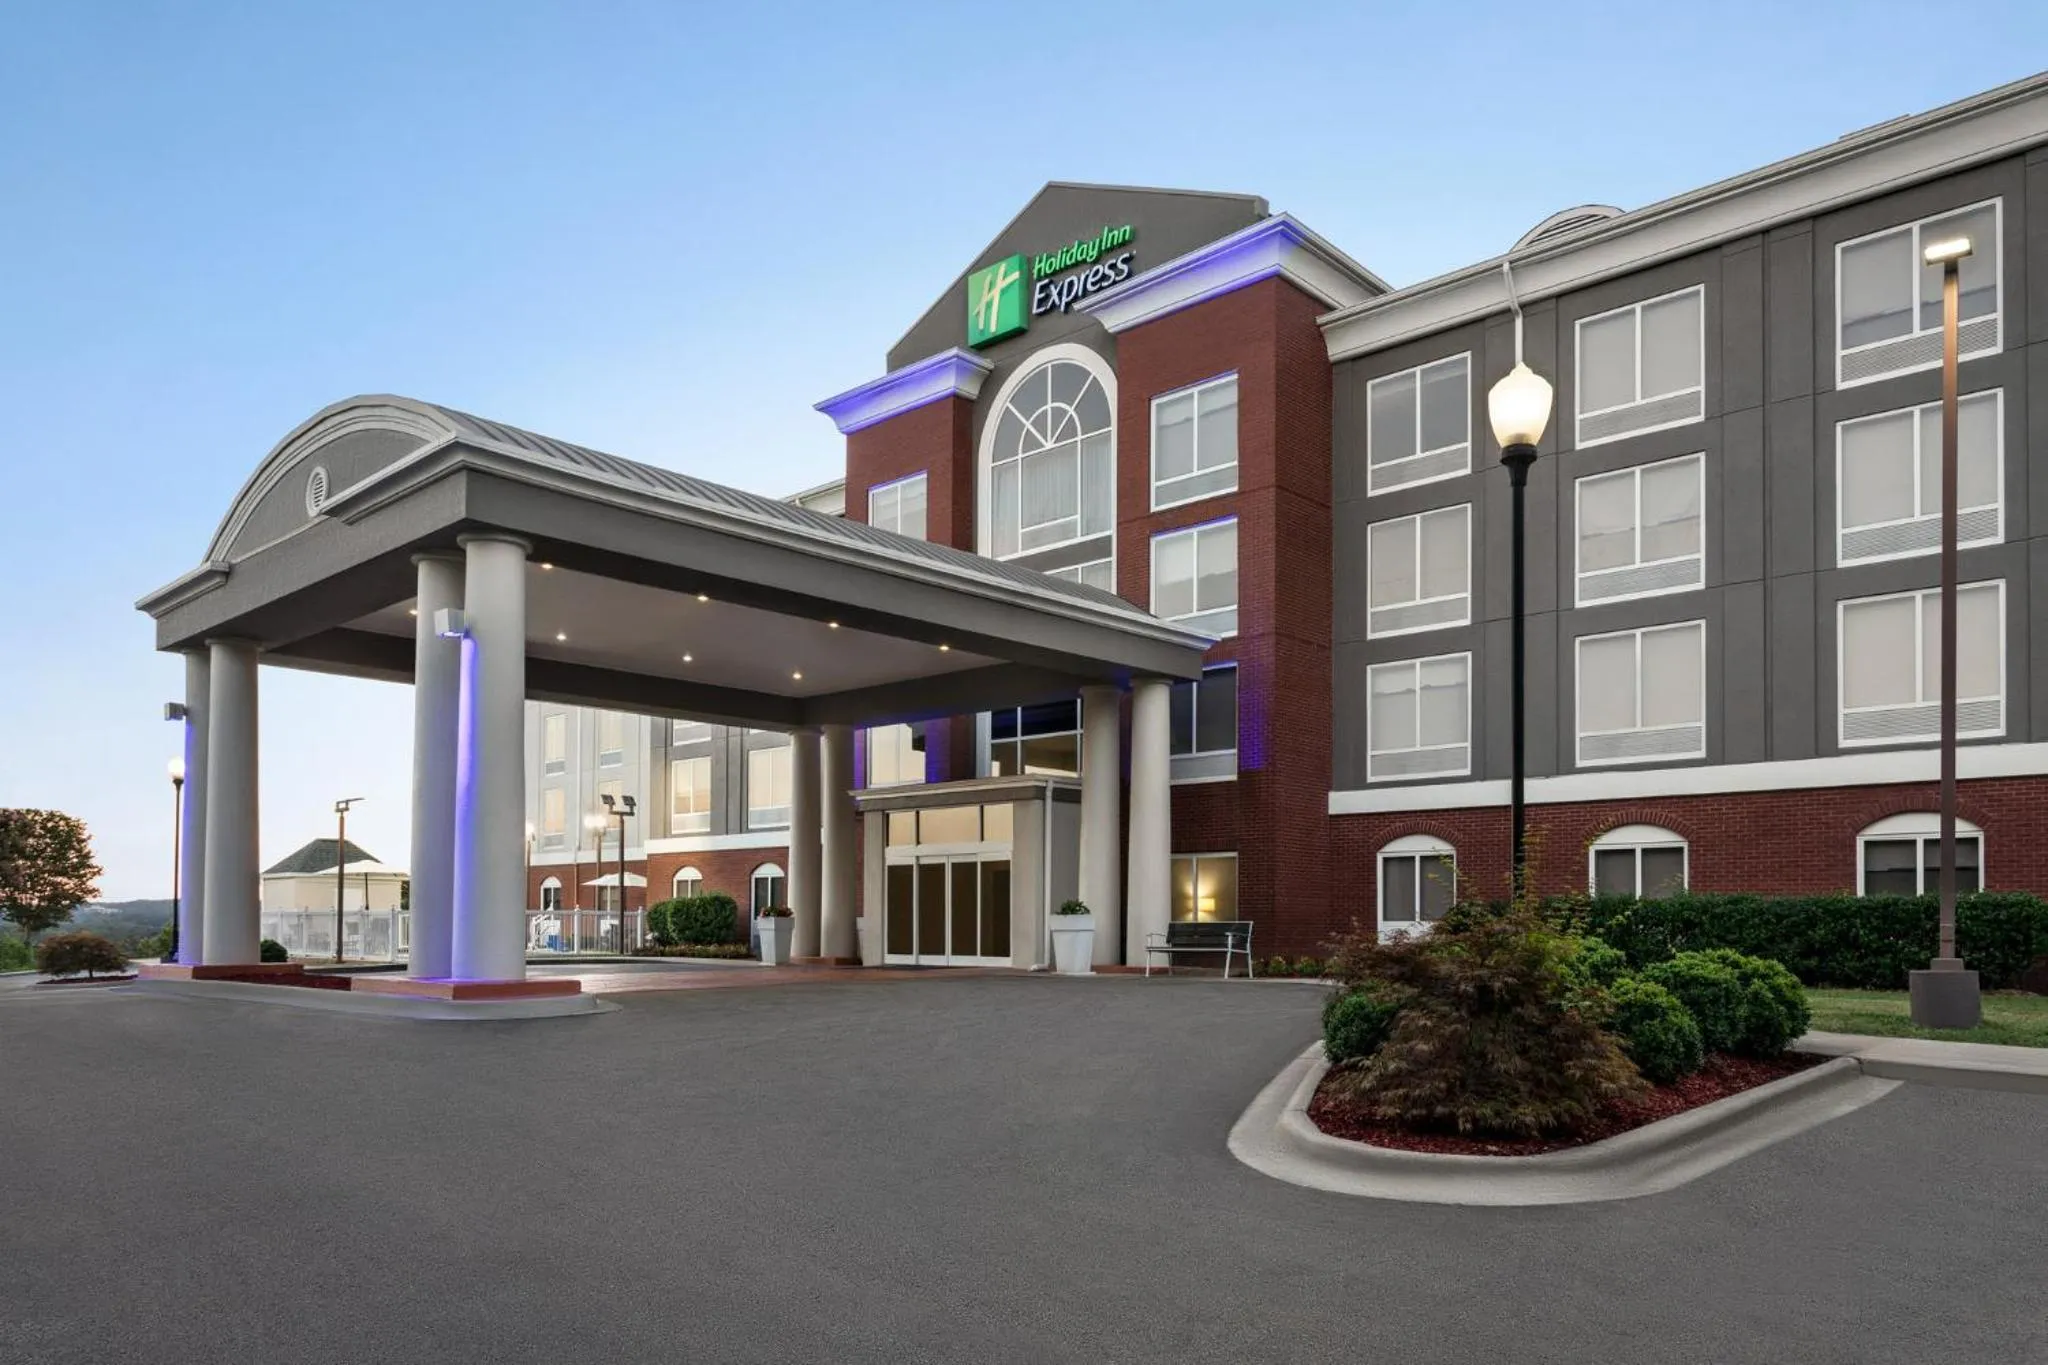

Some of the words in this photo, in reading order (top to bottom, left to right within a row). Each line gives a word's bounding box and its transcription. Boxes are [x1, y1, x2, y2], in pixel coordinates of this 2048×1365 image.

[1032, 236, 1102, 279] Holiday
[1101, 224, 1133, 249] Inn
[1031, 252, 1131, 315] Express
